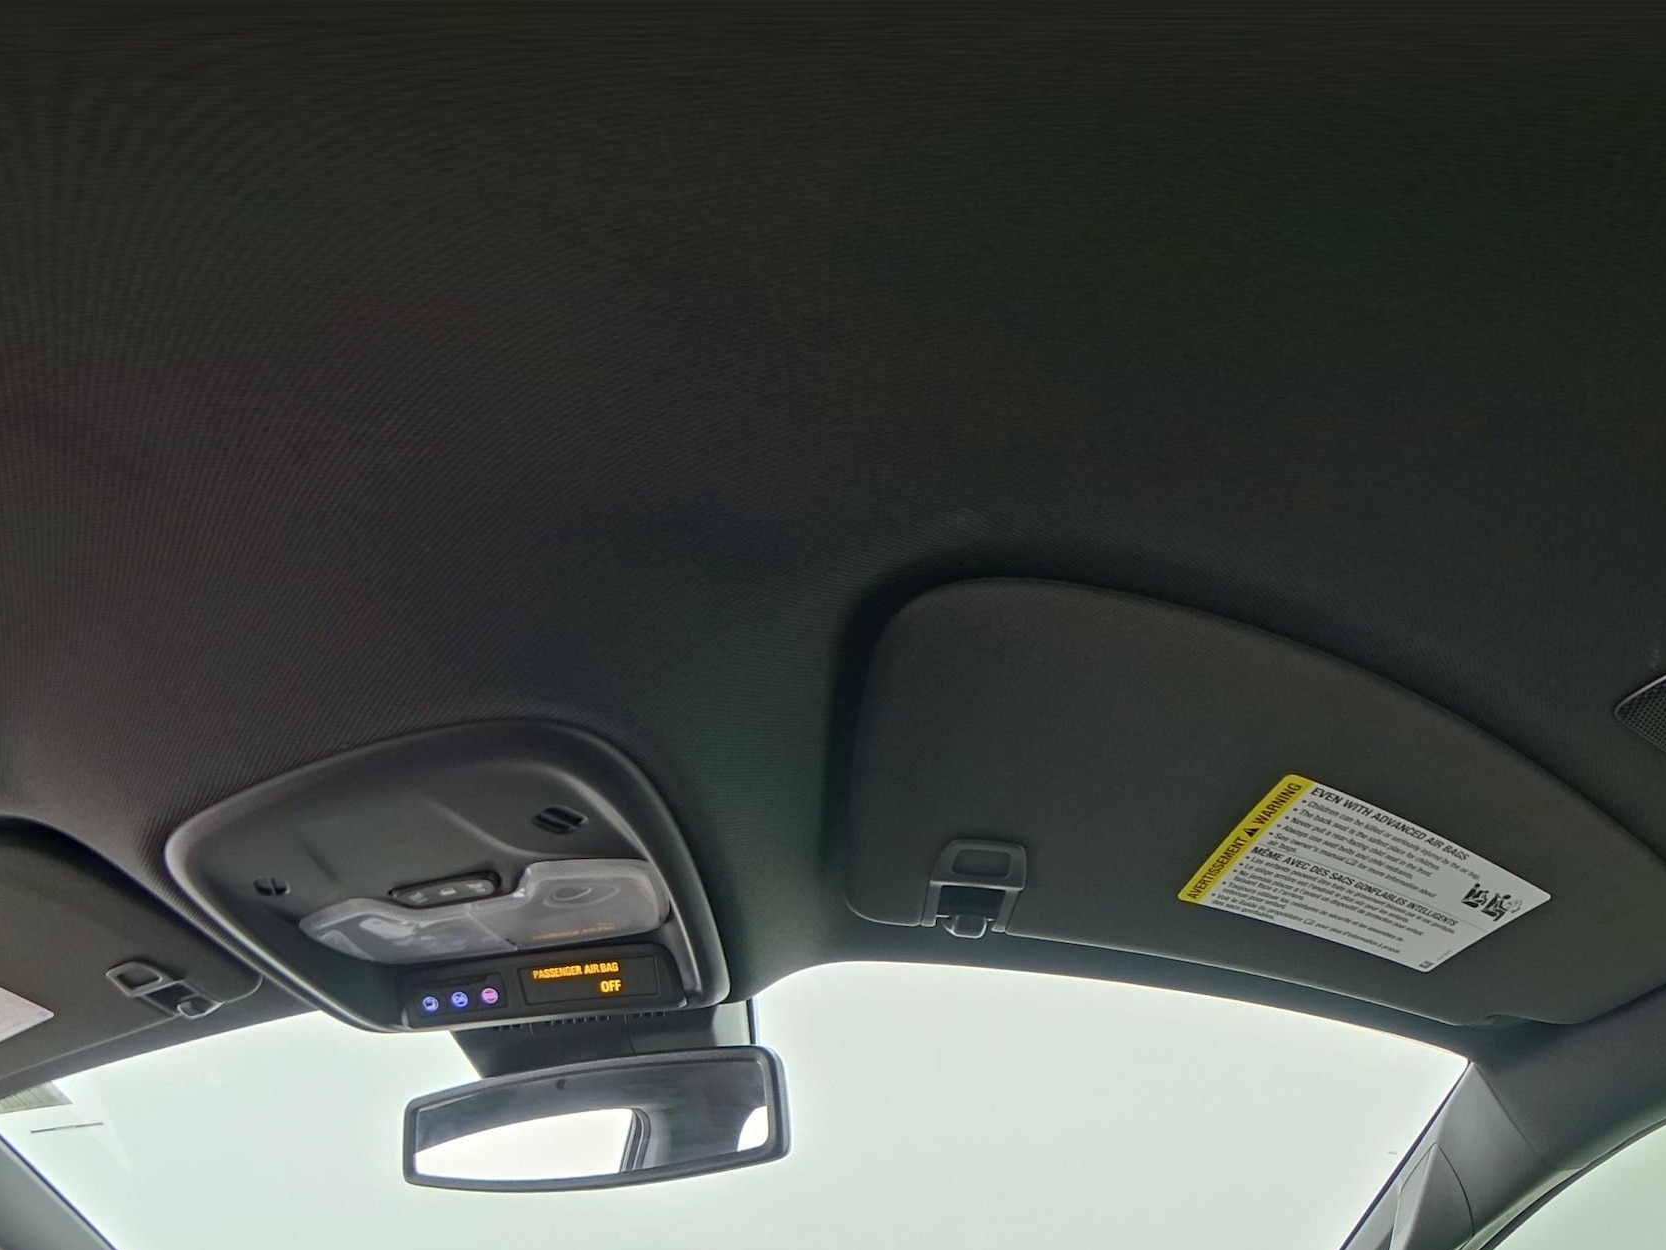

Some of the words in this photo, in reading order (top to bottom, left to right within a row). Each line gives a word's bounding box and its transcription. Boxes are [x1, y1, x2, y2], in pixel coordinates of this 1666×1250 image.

[1253, 782, 1302, 825] WARNING
[1310, 786, 1342, 805] EVEN
[1342, 799, 1372, 816] WITH
[1370, 812, 1427, 840] ADVANCED
[1424, 836, 1445, 848] AIR
[1441, 845, 1470, 860] BAGS
[1187, 837, 1248, 900] AVERTISSEMENT
[1251, 844, 1284, 861] MÊME
[1282, 856, 1310, 870] AVEC
[1309, 865, 1330, 876] DES
[1328, 872, 1355, 885] SACS
[1352, 881, 1409, 905] GONFLABLES
[1403, 902, 1461, 926] INTELLIGENTS
[533, 965, 583, 979] PASSENGER
[584, 963, 599, 975] AIR
[600, 962, 619, 973] BAG
[600, 979, 622, 993] OFF
